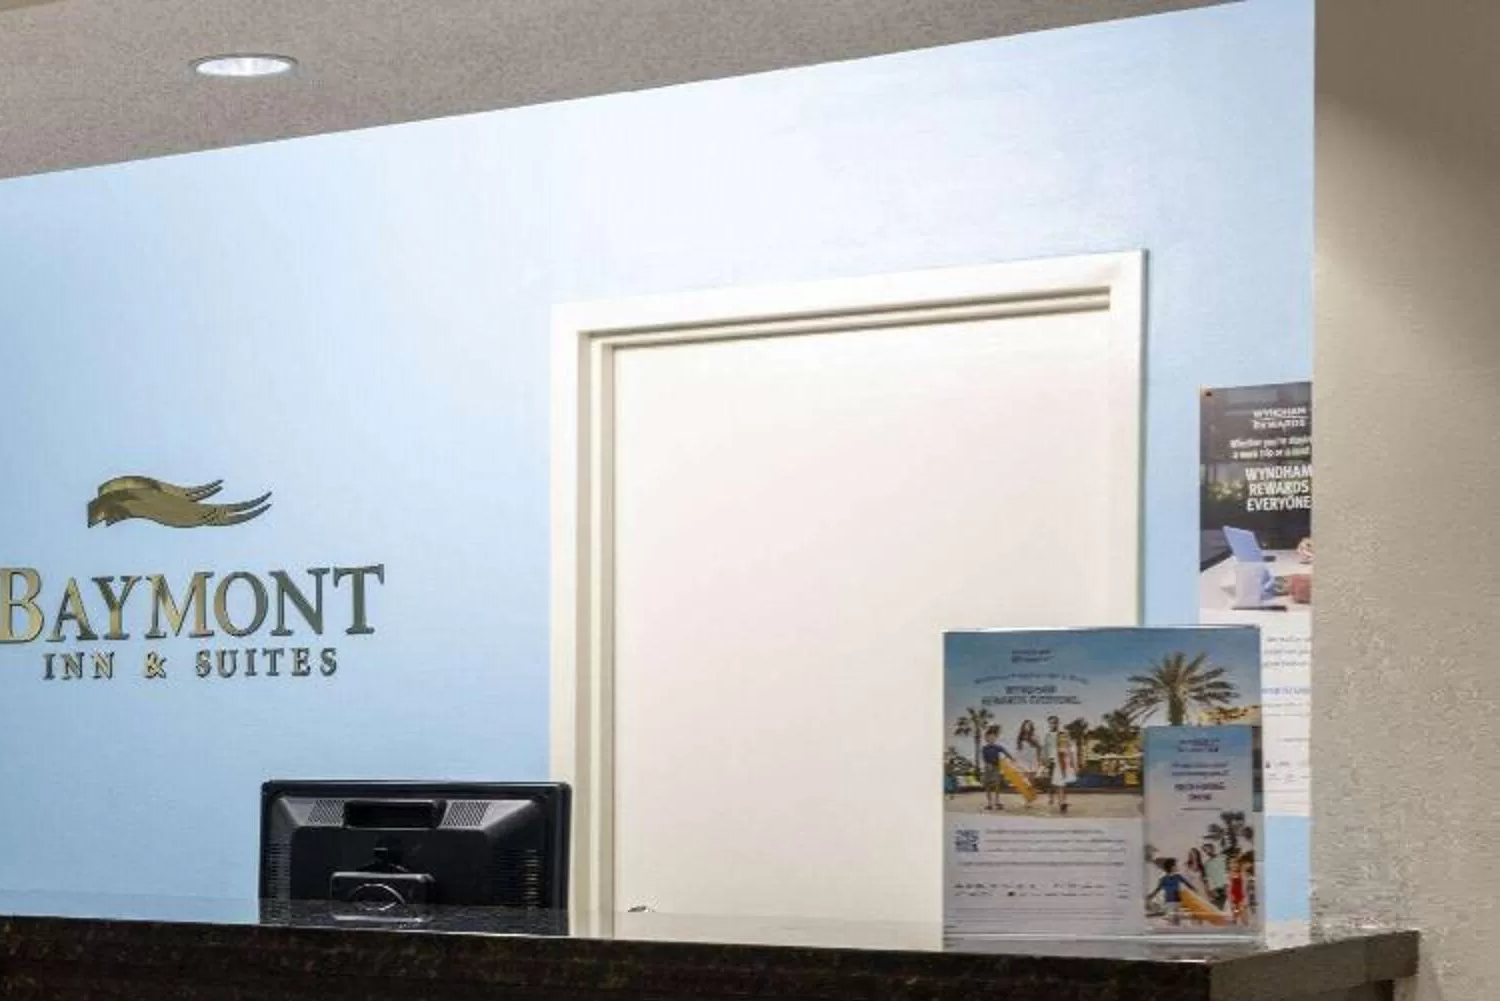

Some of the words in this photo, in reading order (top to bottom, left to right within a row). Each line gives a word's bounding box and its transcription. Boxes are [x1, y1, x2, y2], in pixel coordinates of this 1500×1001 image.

[1245, 464, 1312, 481] WYNDHAM
[1249, 480, 1309, 496] REWARDS
[42, 652, 115, 680] INN
[143, 651, 167, 679] &
[195, 647, 338, 678] SUITES
